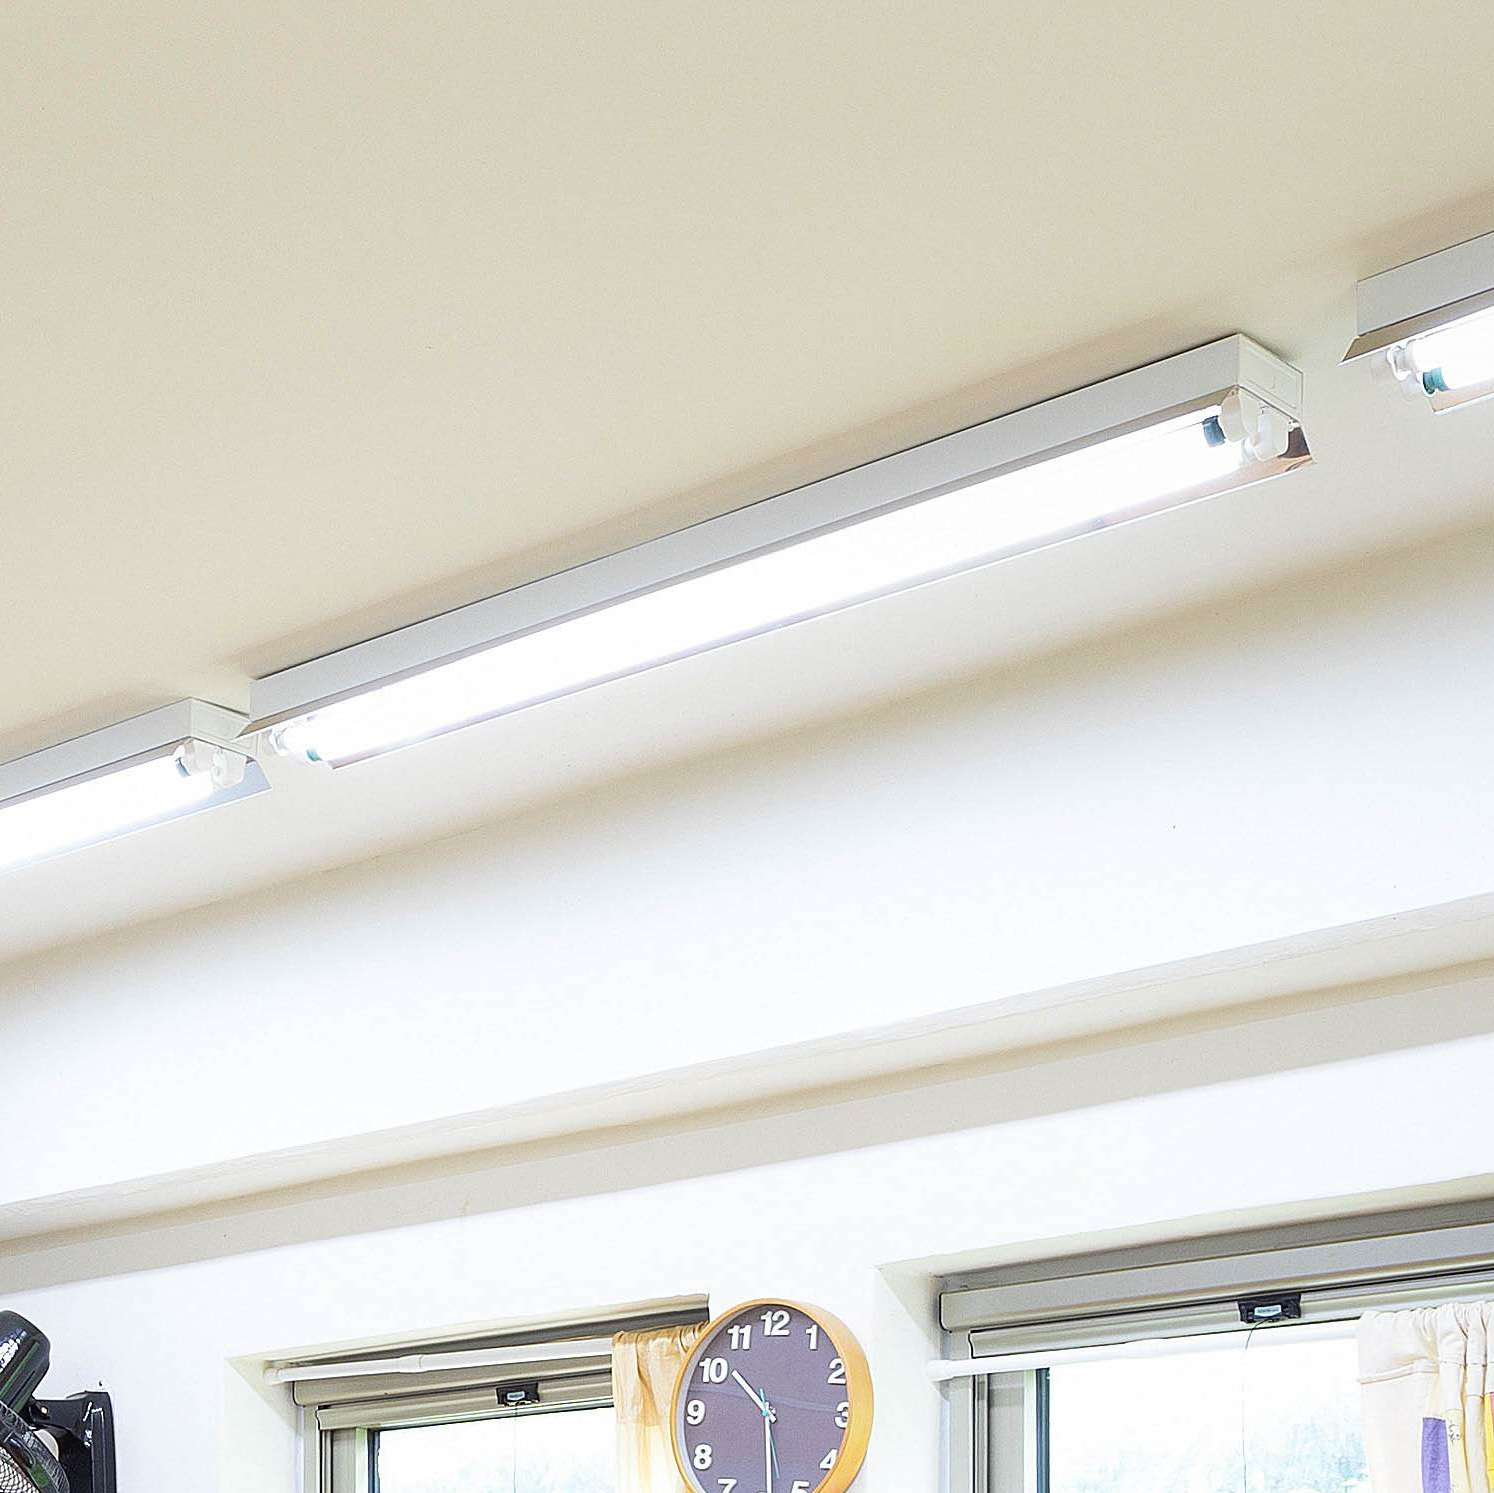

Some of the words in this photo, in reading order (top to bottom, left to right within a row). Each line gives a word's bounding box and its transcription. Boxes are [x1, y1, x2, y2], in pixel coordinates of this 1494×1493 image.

[761, 1310, 790, 1336] 12
[727, 1324, 752, 1350] 11
[805, 1324, 818, 1350] 1
[698, 1357, 728, 1383] 10
[827, 1358, 846, 1384] 2
[686, 1400, 705, 1425] 9
[834, 1402, 849, 1429] 3
[693, 1444, 712, 1469] 8
[819, 1449, 839, 1469] 4
